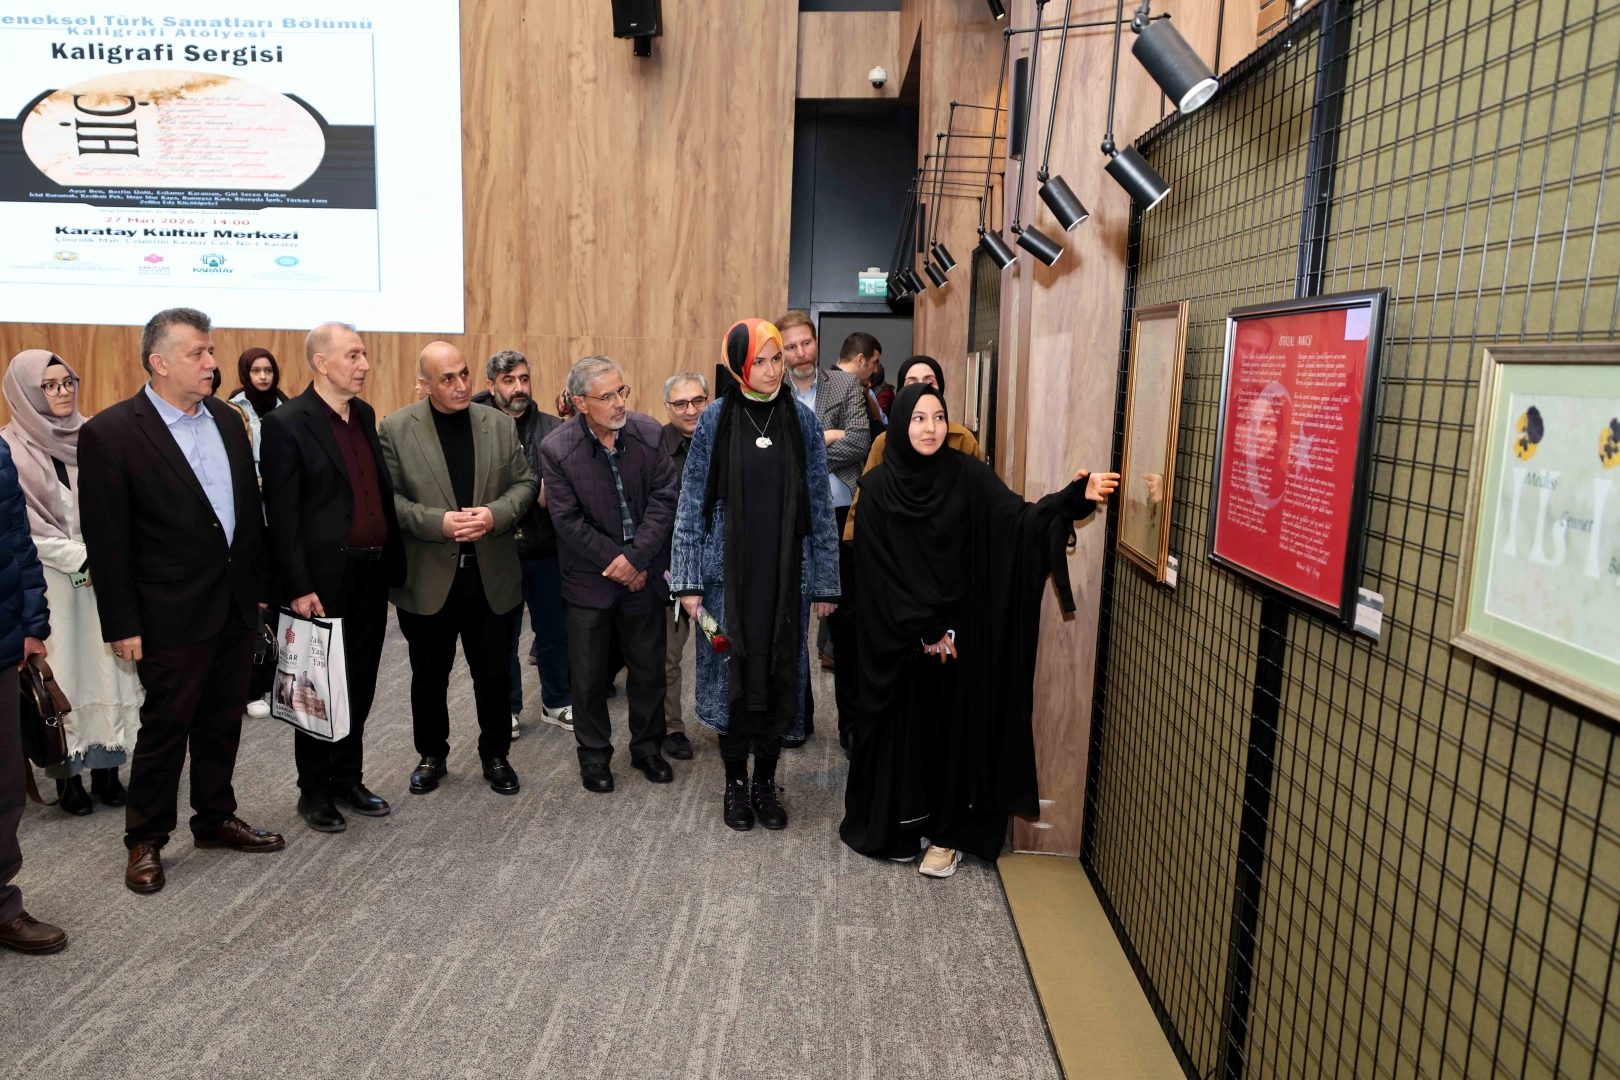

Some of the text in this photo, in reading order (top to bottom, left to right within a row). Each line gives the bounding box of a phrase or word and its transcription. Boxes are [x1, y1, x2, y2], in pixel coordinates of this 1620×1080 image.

[103, 15, 155, 27] Türk
[162, 16, 273, 28] Sanatları
[282, 17, 373, 29] Bölümü
[67, 26, 266, 39] Kaligrafi Atölyesi
[51, 42, 283, 66] Kaligrafi Sergisi
[55, 226, 299, 239] Karatay Kültür Merkezi
